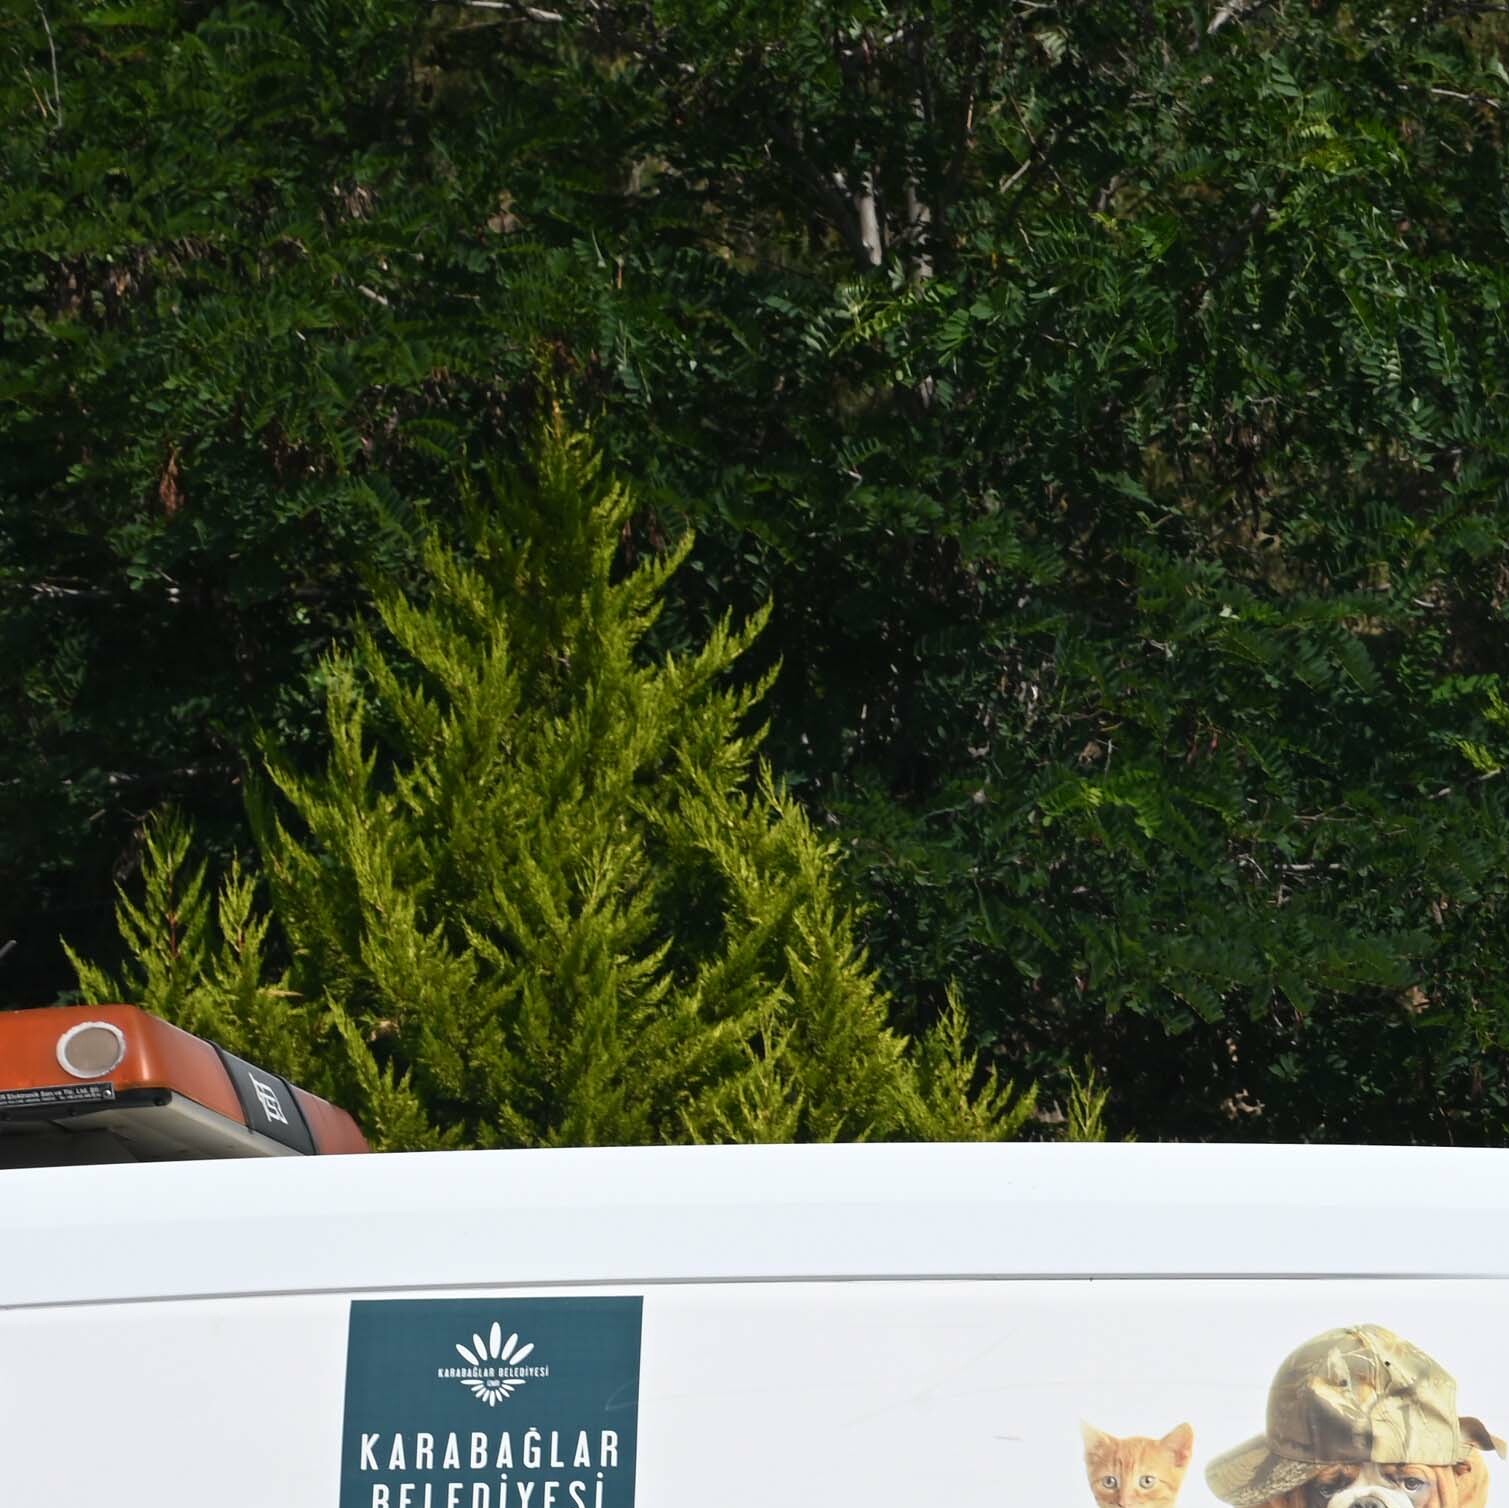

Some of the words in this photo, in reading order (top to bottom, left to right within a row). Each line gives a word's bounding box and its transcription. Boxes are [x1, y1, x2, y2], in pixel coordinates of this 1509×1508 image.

[438, 1367, 495, 1378] KARABAĞLAR
[498, 1365, 549, 1377] BELEDİYESİ
[360, 1426, 619, 1471] KARABAĞLAR
